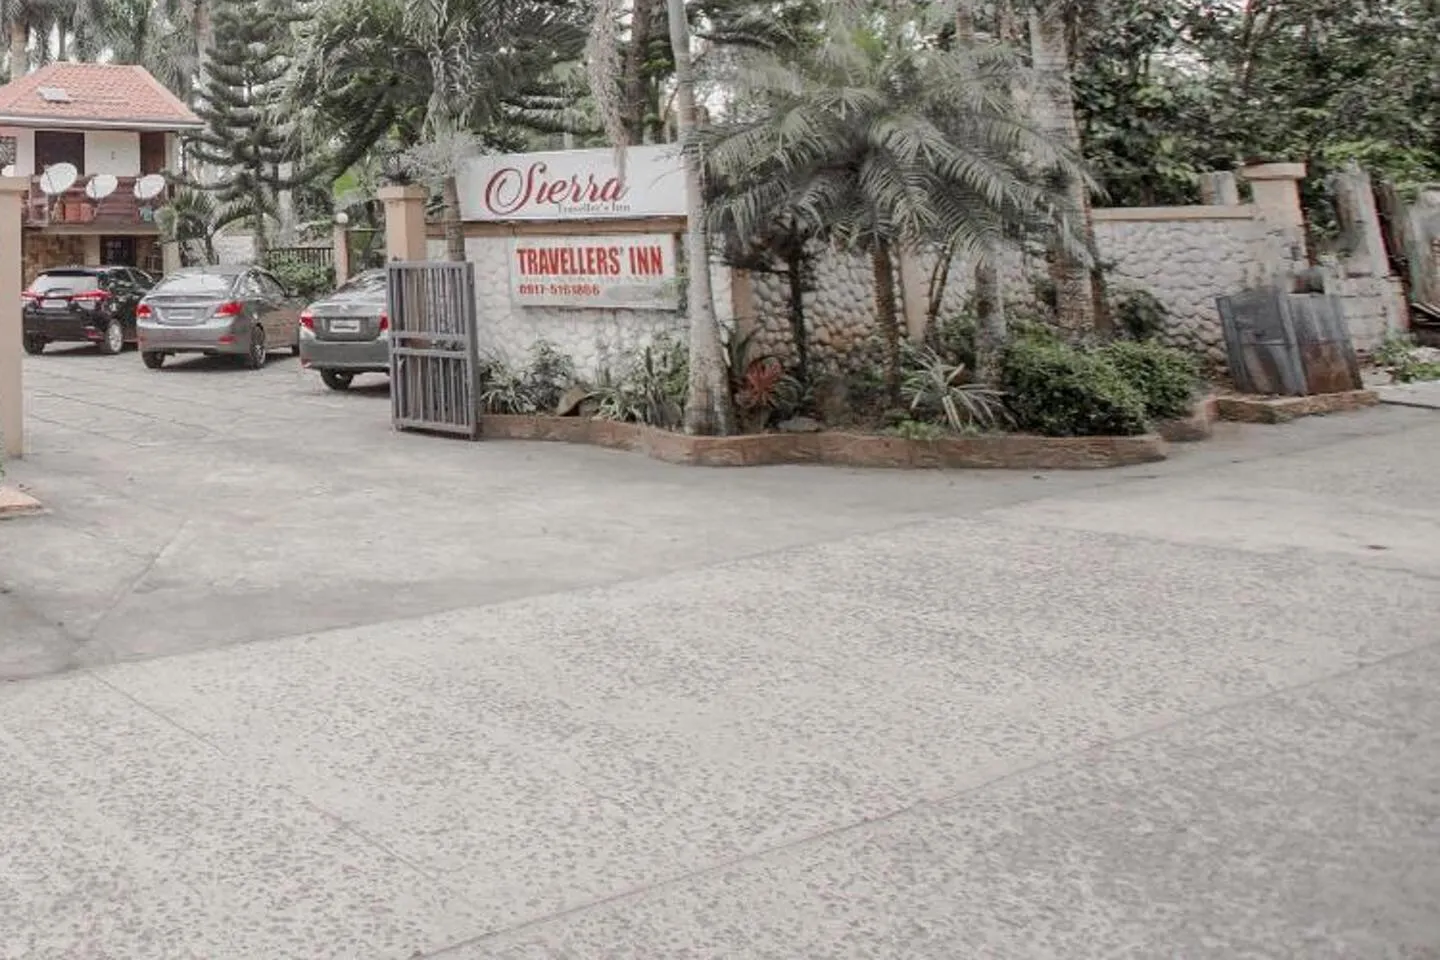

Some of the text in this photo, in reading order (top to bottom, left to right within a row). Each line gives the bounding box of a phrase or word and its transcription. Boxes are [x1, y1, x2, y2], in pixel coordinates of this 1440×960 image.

[484, 161, 628, 216] Sierra
[612, 202, 631, 213] Inn
[516, 245, 664, 276] TRAVELLERS' INN
